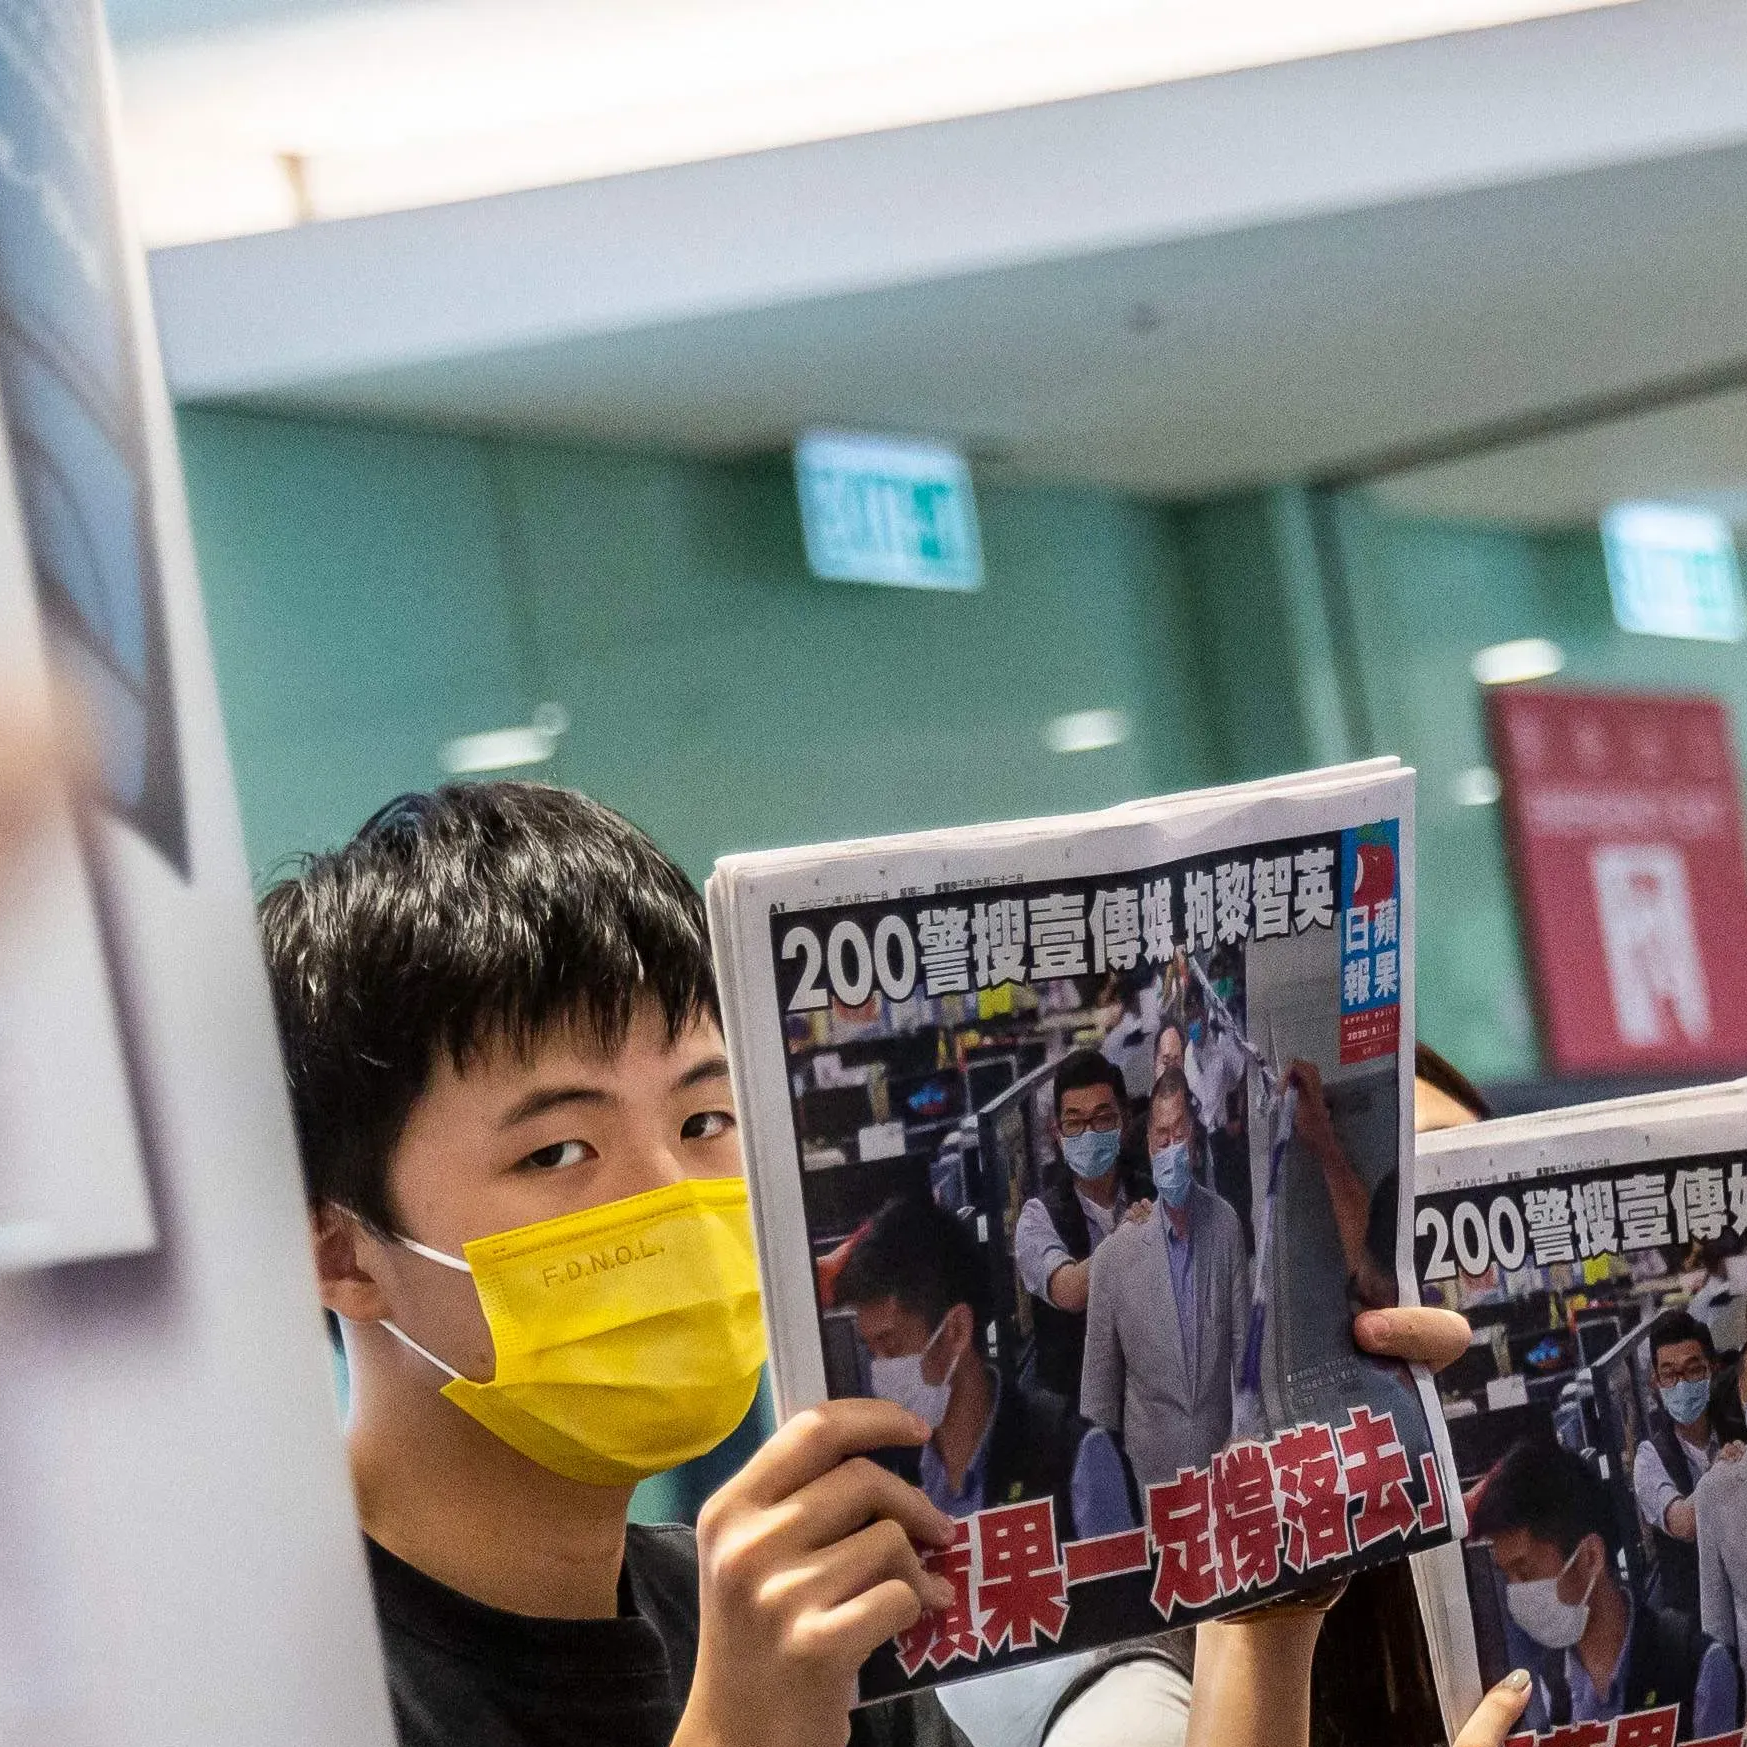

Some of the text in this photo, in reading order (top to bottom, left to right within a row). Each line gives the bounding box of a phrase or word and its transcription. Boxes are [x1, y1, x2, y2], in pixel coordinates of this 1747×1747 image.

[1185, 846, 1335, 954] 拘黎智英
[542, 1239, 666, 1287] F.D.N.O.L.
